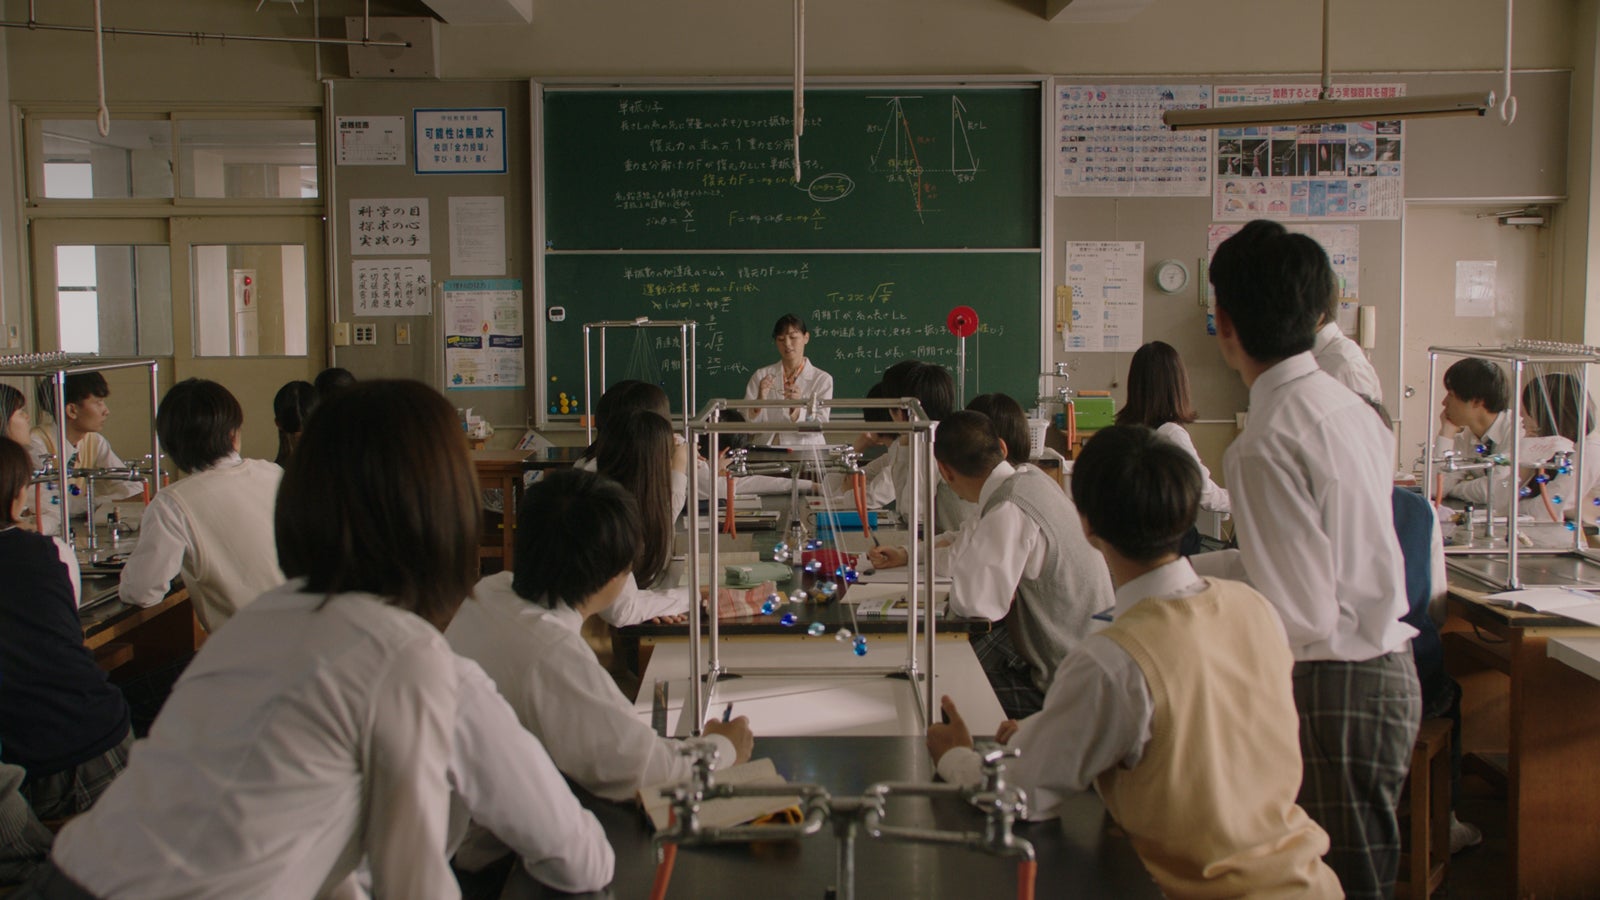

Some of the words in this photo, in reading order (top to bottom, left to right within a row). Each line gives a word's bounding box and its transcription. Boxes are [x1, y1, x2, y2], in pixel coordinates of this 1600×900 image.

[1273, 87, 1402, 99] 加熱するとき使う実験器具を確認！
[618, 99, 664, 115] 単振り子
[425, 127, 494, 139] 可能性は無限大
[358, 206, 420, 218] 科学の目
[358, 220, 420, 232] 探求の心
[359, 235, 420, 246] 実践の手
[417, 274, 427, 297] 校訓
